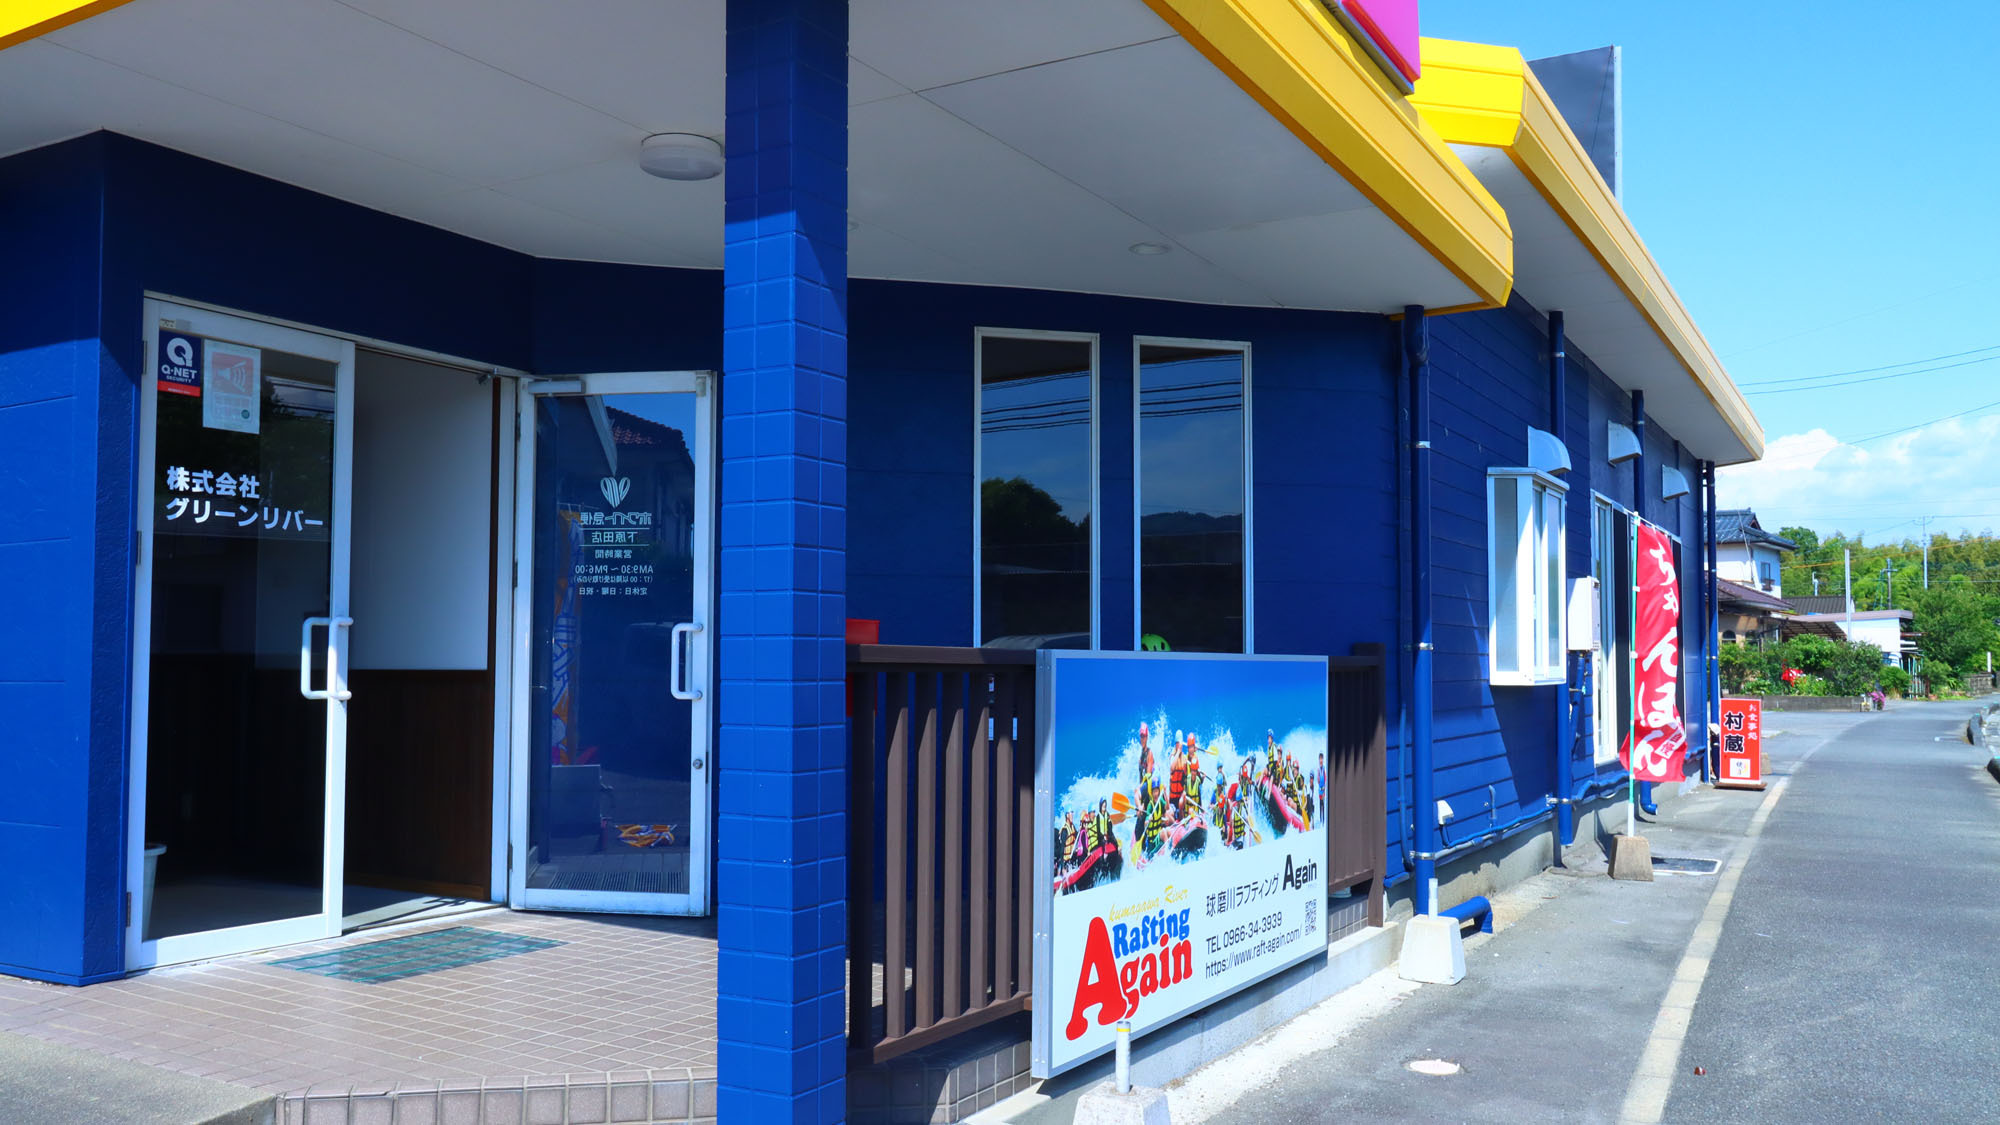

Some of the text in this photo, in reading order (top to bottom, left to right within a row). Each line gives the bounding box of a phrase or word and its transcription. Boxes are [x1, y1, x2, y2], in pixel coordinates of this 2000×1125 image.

[166, 375, 192, 384] SECURITY
[166, 465, 260, 499] 株式会社
[166, 497, 323, 532] グリーンリバー
[1724, 711, 1744, 753] 村蔵
[1747, 703, 1758, 741] お食事処
[1205, 853, 1318, 918] 球磨川ラフティング Again
[1112, 907, 1190, 960] Rafting
[1205, 911, 1283, 955] TEL 0966-34-3939
[1065, 916, 1193, 1041] Again
